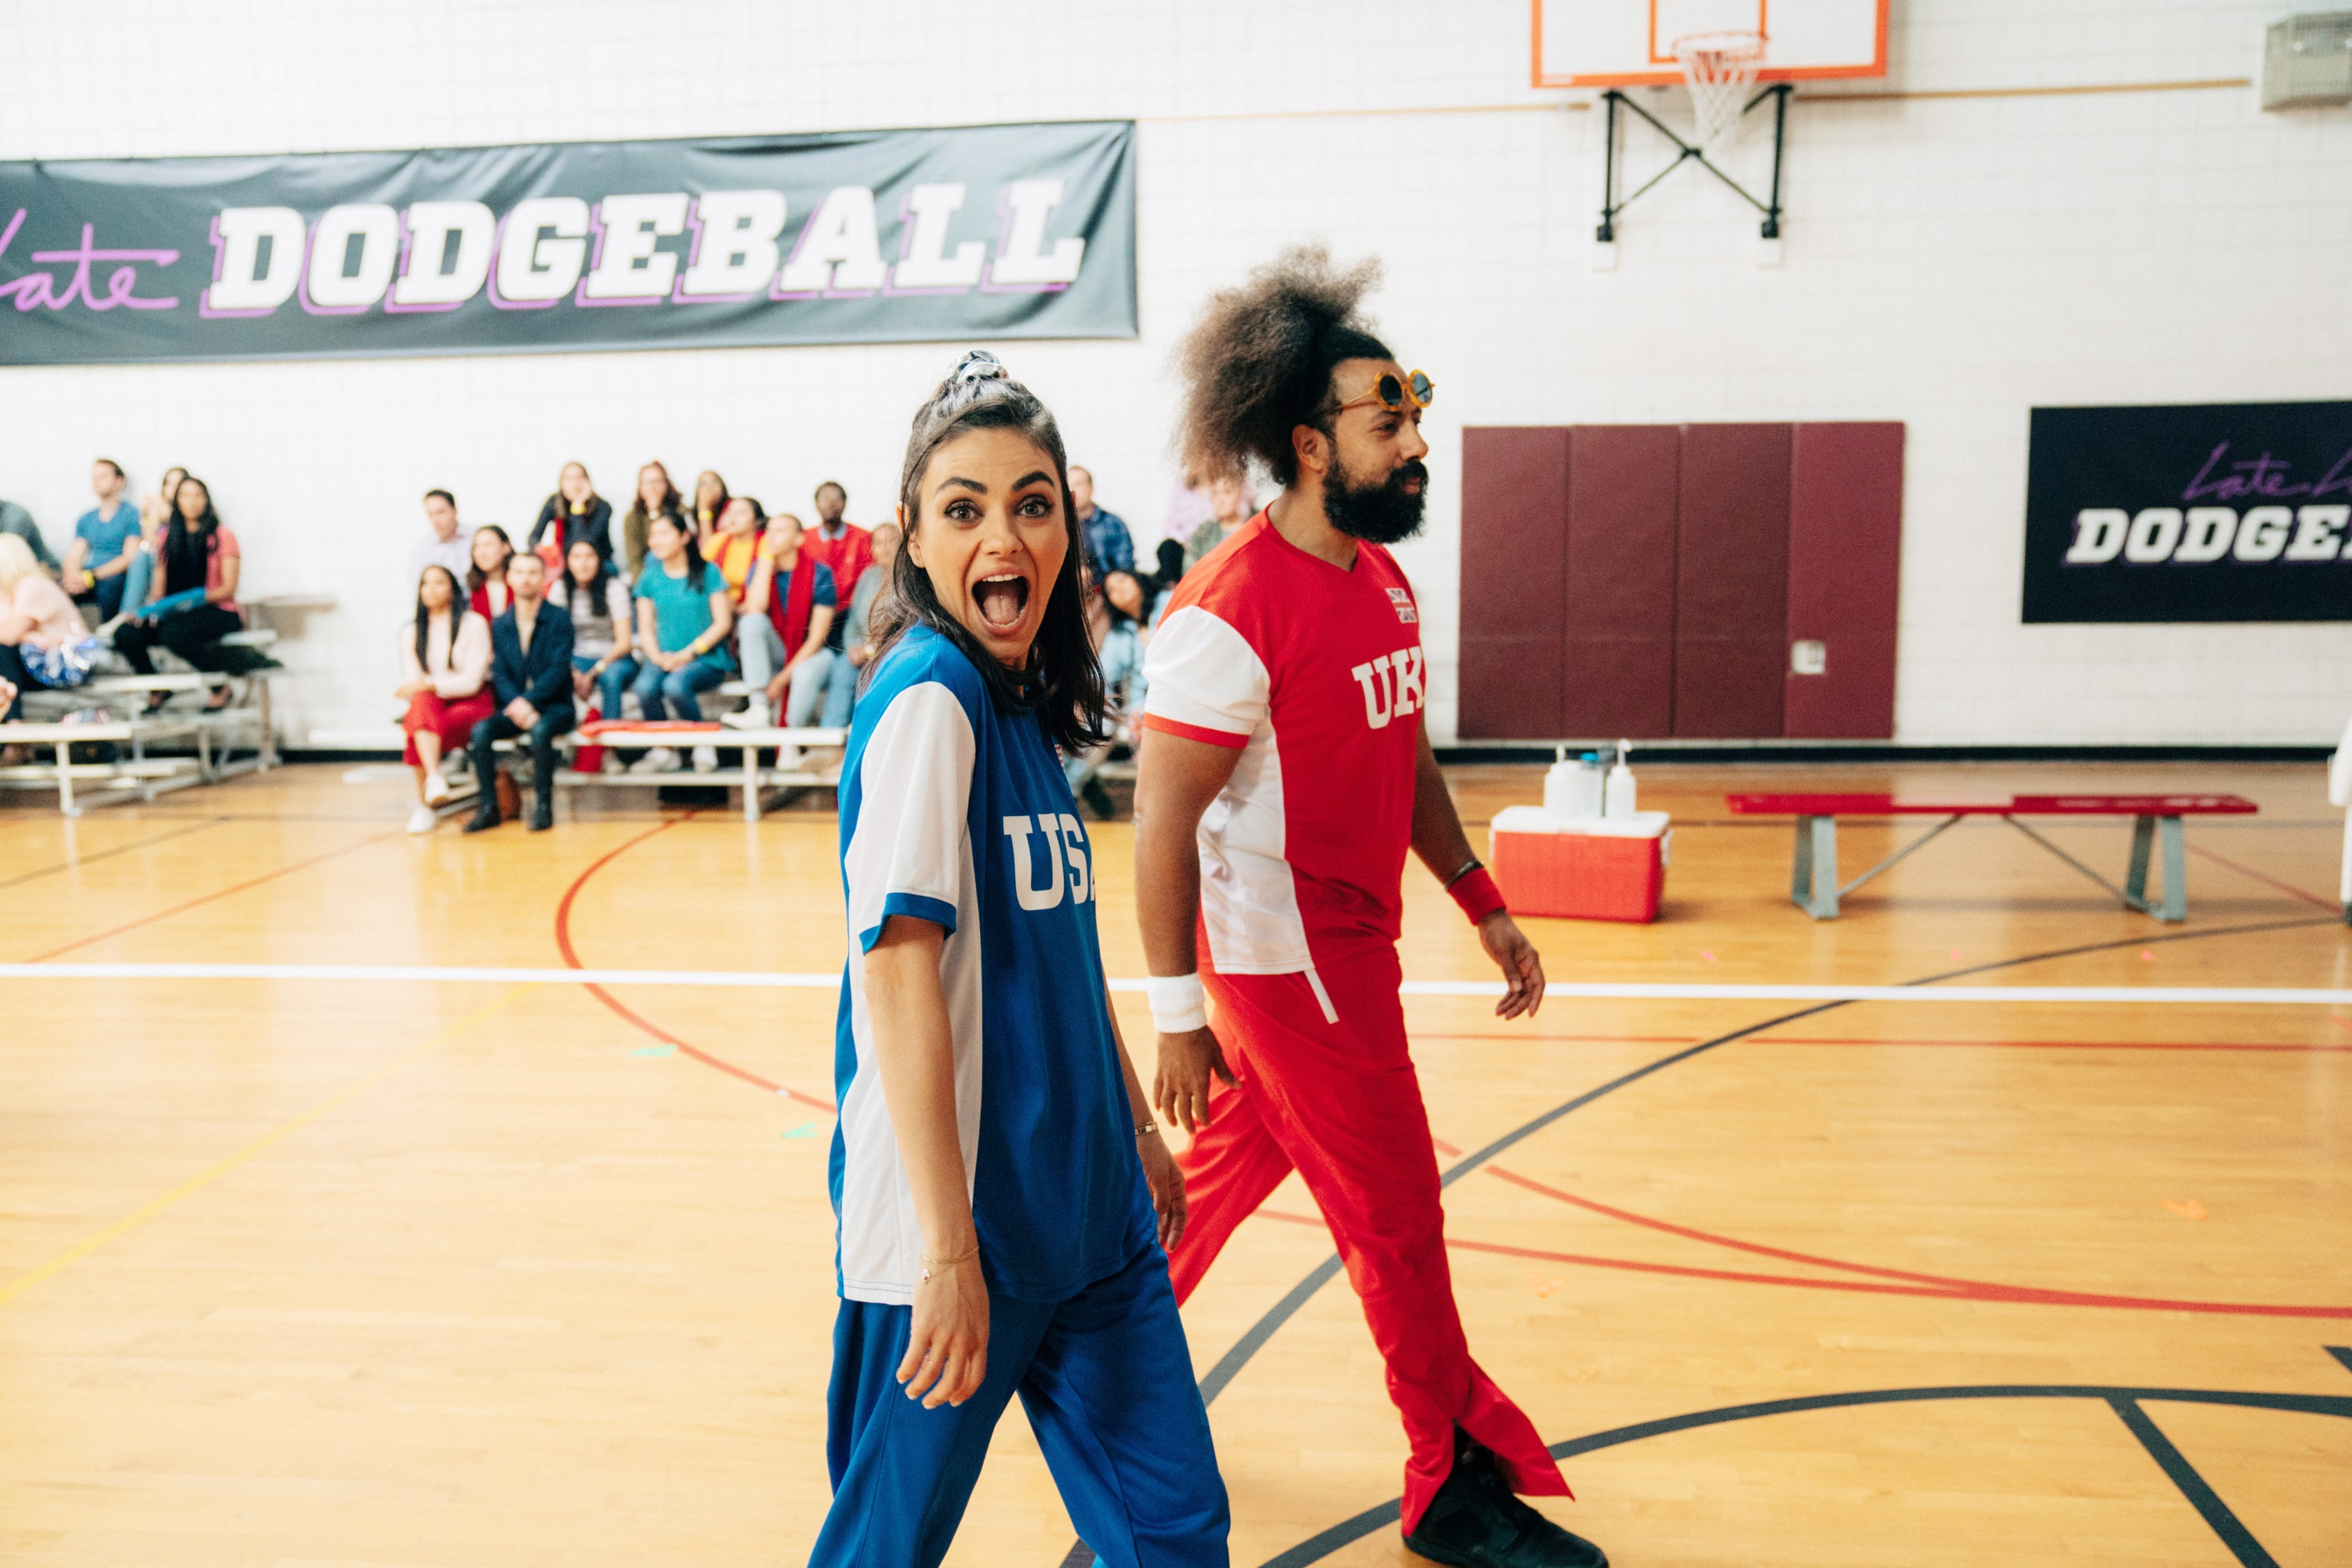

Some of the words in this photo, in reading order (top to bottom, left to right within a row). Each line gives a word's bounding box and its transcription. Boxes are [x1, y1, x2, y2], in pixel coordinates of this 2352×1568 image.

[208, 180, 1085, 310] DODGEBALL
[2183, 441, 2311, 500] Late
[2064, 503, 2352, 564] DODGE
[1351, 645, 1425, 729] UK
